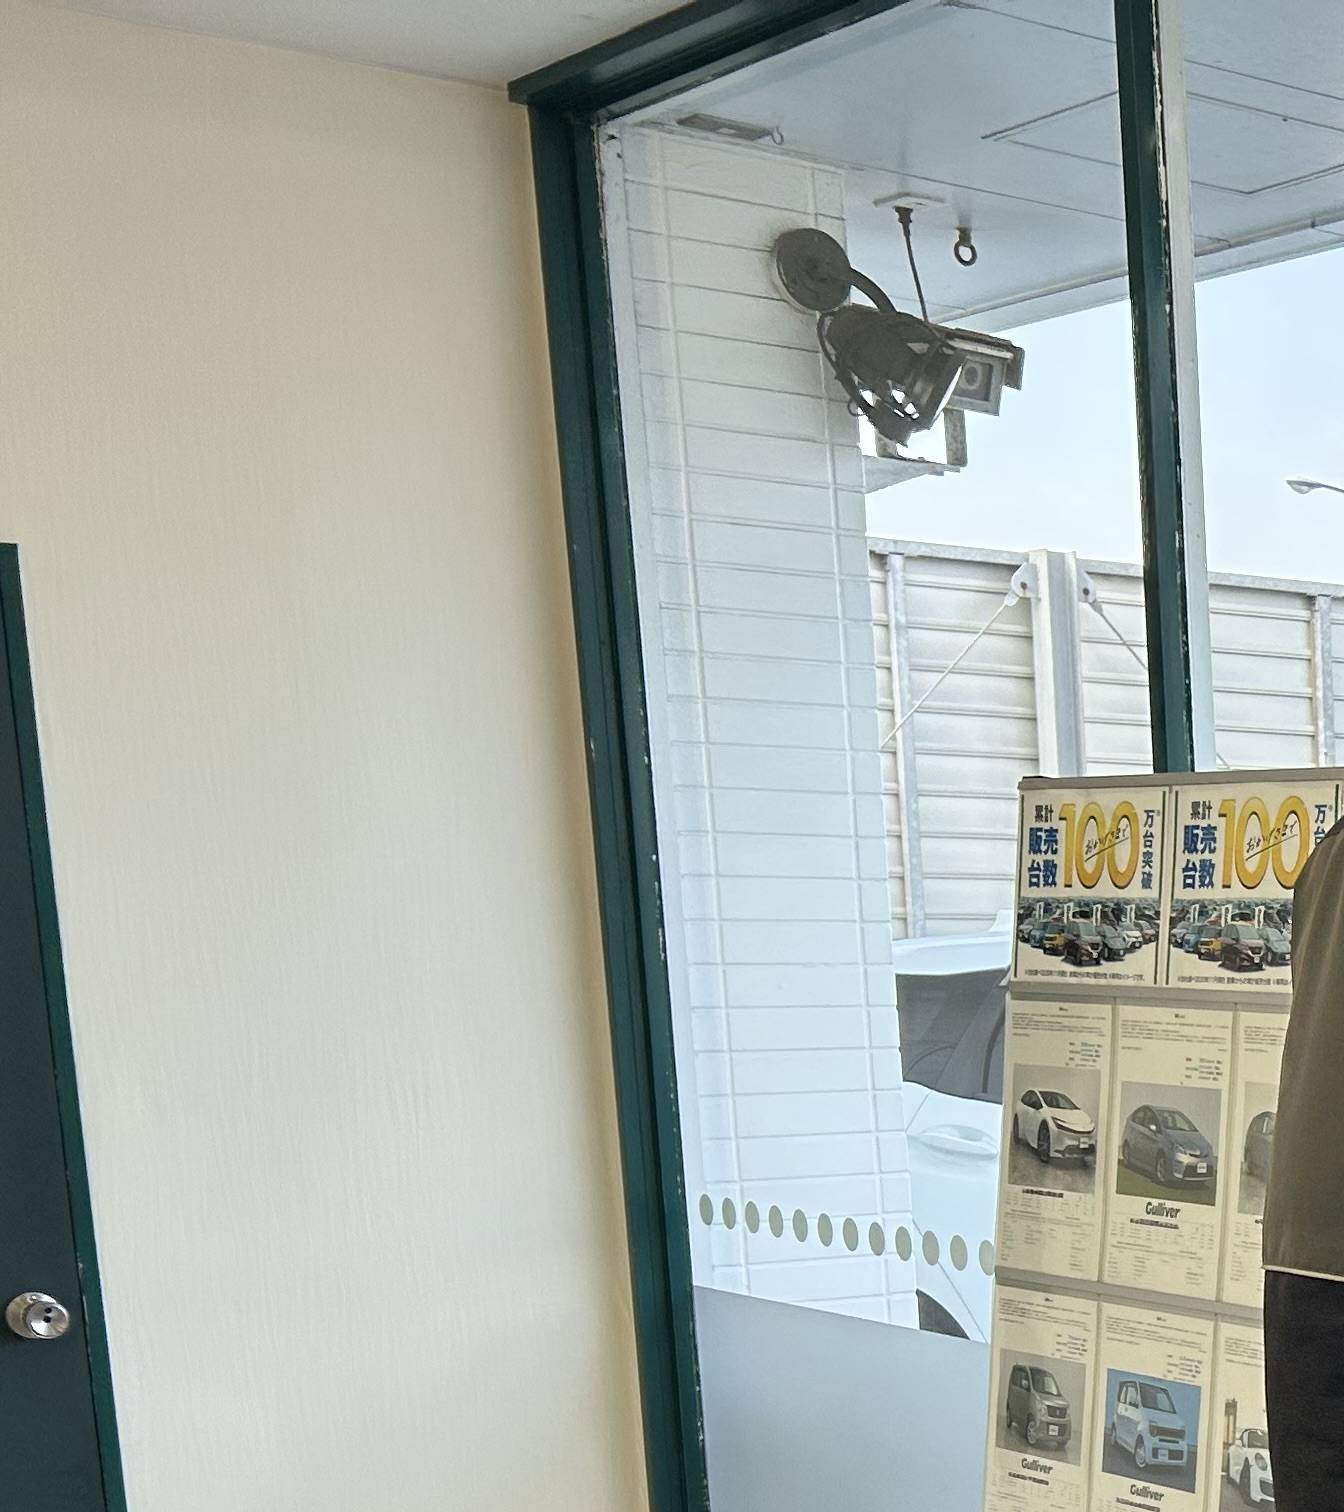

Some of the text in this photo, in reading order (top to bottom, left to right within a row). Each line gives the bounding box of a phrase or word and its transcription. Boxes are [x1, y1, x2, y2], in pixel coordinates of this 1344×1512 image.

[1034, 804, 1054, 823] 累計
[1190, 801, 1213, 820] 累計
[1028, 827, 1059, 855] 販売
[1059, 801, 1139, 889] 100
[1182, 823, 1217, 855] 販売
[1218, 795, 1310, 890] 100
[1028, 860, 1058, 889] 台数
[1182, 859, 1216, 890] 台数
